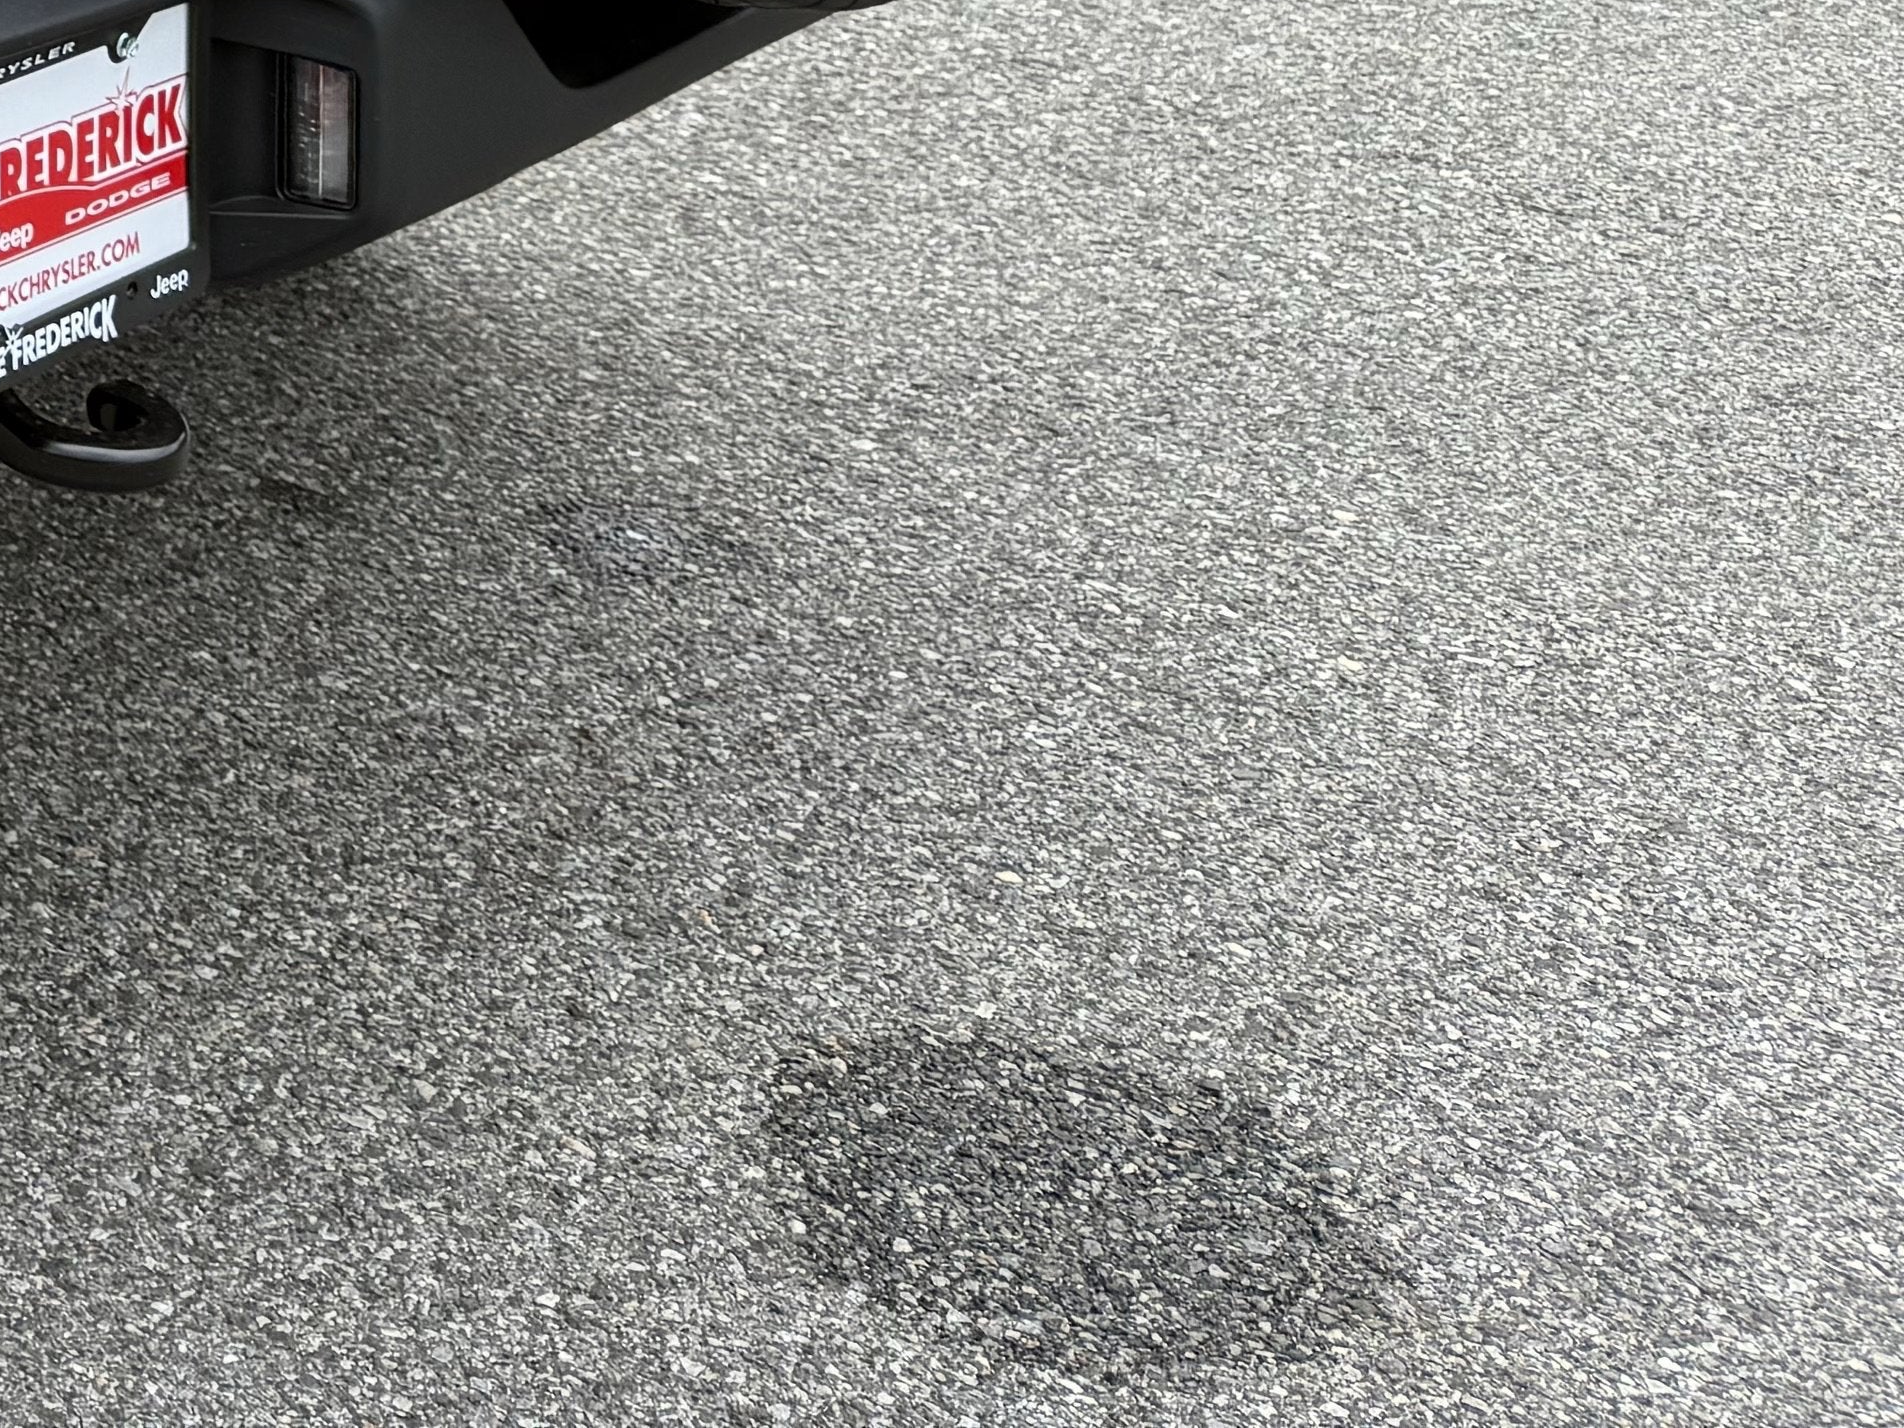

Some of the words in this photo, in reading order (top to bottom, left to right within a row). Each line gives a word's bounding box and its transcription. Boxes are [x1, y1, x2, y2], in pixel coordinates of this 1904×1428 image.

[64, 170, 172, 226] DODGE
[149, 268, 189, 299] Jeep
[9, 294, 119, 371] FREDERICK
